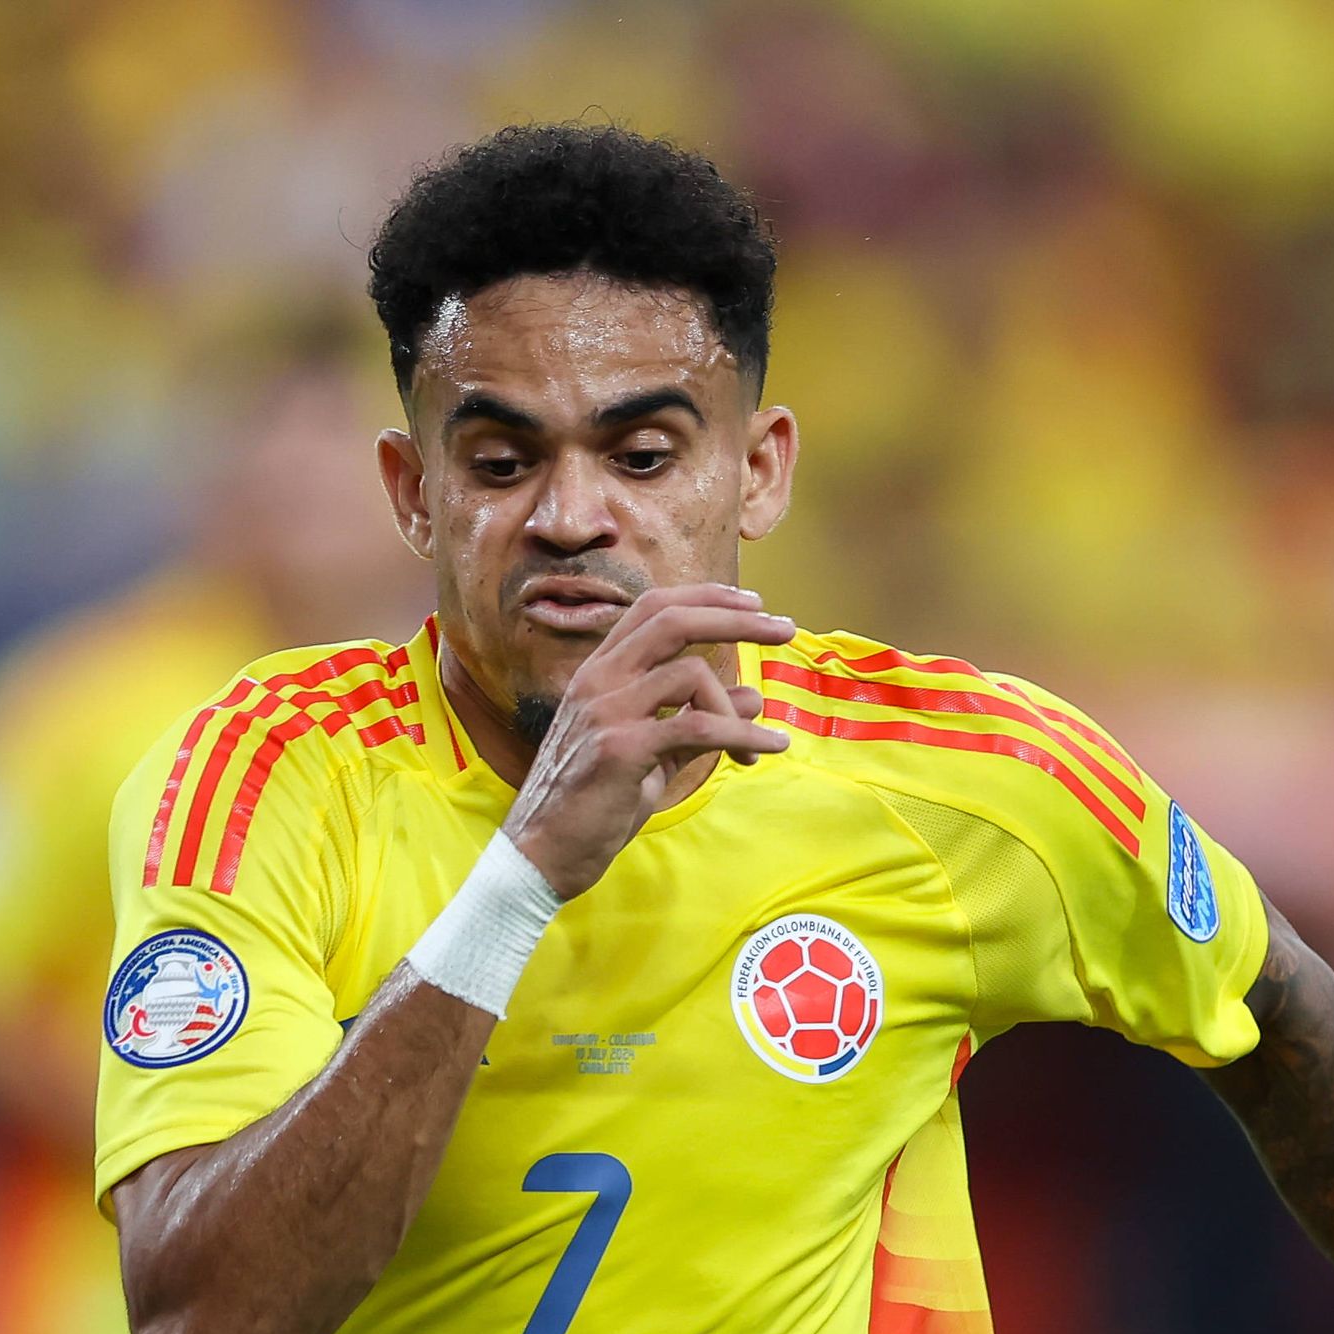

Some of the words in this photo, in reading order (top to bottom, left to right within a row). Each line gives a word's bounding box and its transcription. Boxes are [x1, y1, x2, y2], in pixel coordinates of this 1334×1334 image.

[149, 938, 175, 952] COPA
[178, 937, 220, 959] AMERICA
[771, 921, 841, 942] COLOMBIANA
[842, 937, 856, 953] DE
[854, 950, 878, 994] FUTBOL
[610, 1047, 635, 1060] 2024
